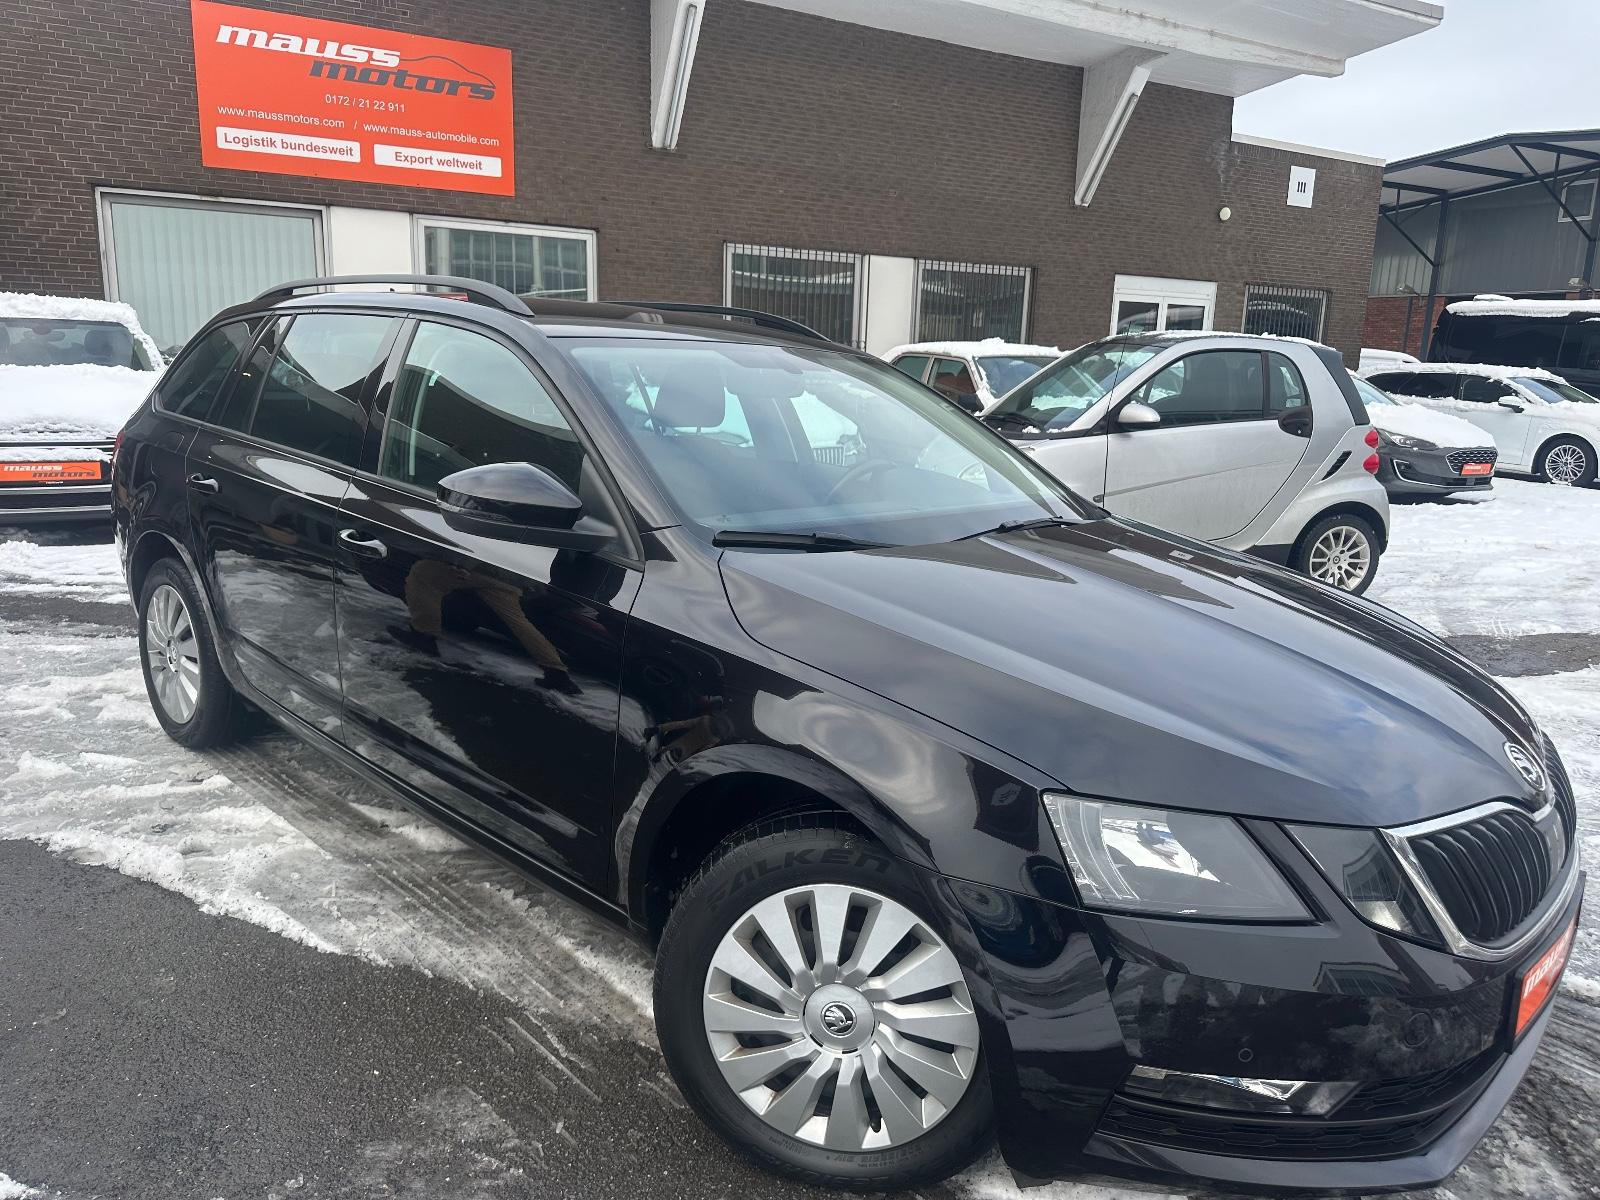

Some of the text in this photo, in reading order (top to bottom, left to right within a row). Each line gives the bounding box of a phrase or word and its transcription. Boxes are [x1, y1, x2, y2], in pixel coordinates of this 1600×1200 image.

[216, 24, 400, 68] mauss
[309, 61, 496, 101] motors
[325, 94, 350, 106] 0172
[358, 98, 370, 109] 21
[374, 100, 386, 111] 22
[388, 102, 406, 113] 911
[217, 105, 345, 129] www.maussmotors.com
[363, 121, 500, 147] www.mauss-automobile.com
[224, 132, 354, 157] Logistik bundesweit
[394, 151, 483, 171] Export weltweit
